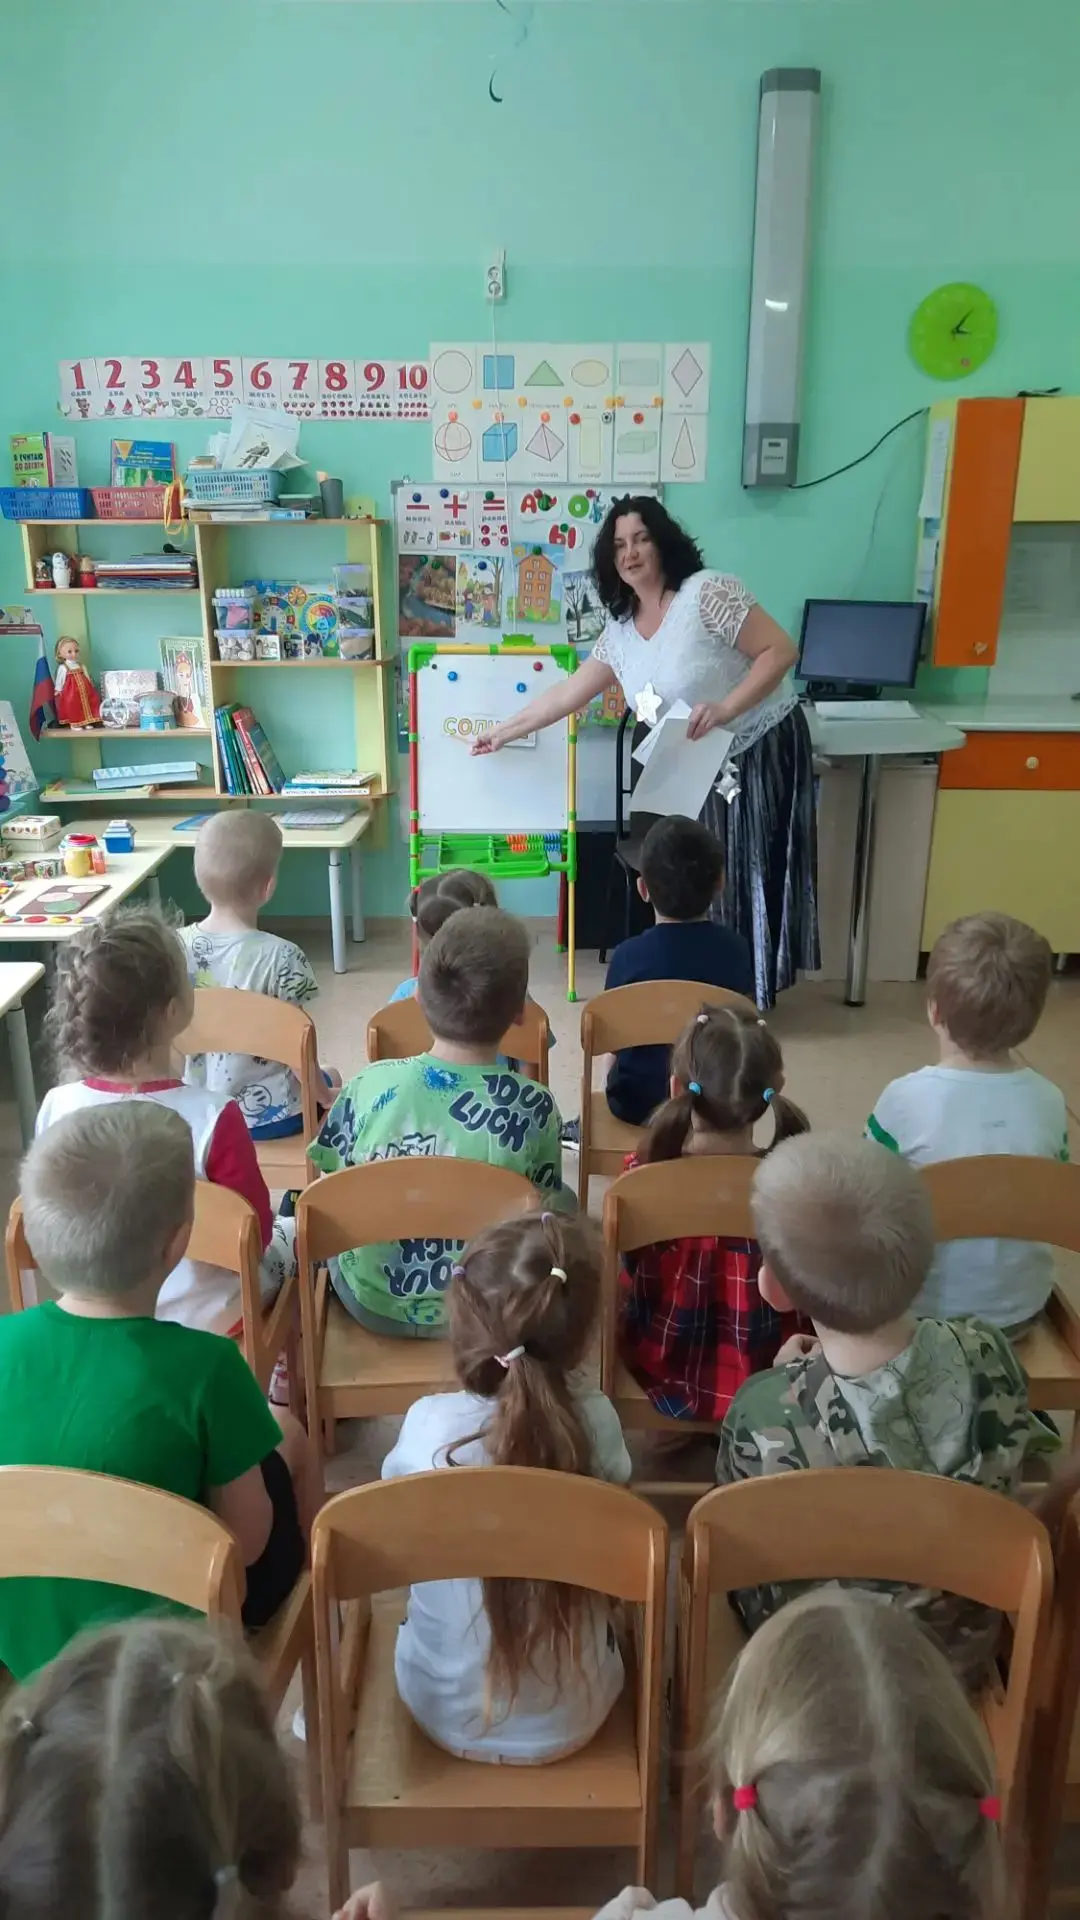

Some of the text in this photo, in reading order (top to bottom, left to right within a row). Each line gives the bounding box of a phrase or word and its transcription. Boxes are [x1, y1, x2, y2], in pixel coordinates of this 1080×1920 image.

[70, 359, 428, 392] 1 2 3 4 5 6 7 8 9 10
[520, 493, 537, 514] А
[443, 717, 503, 736] СОЛ
[383, 1256, 455, 1298] OUR
